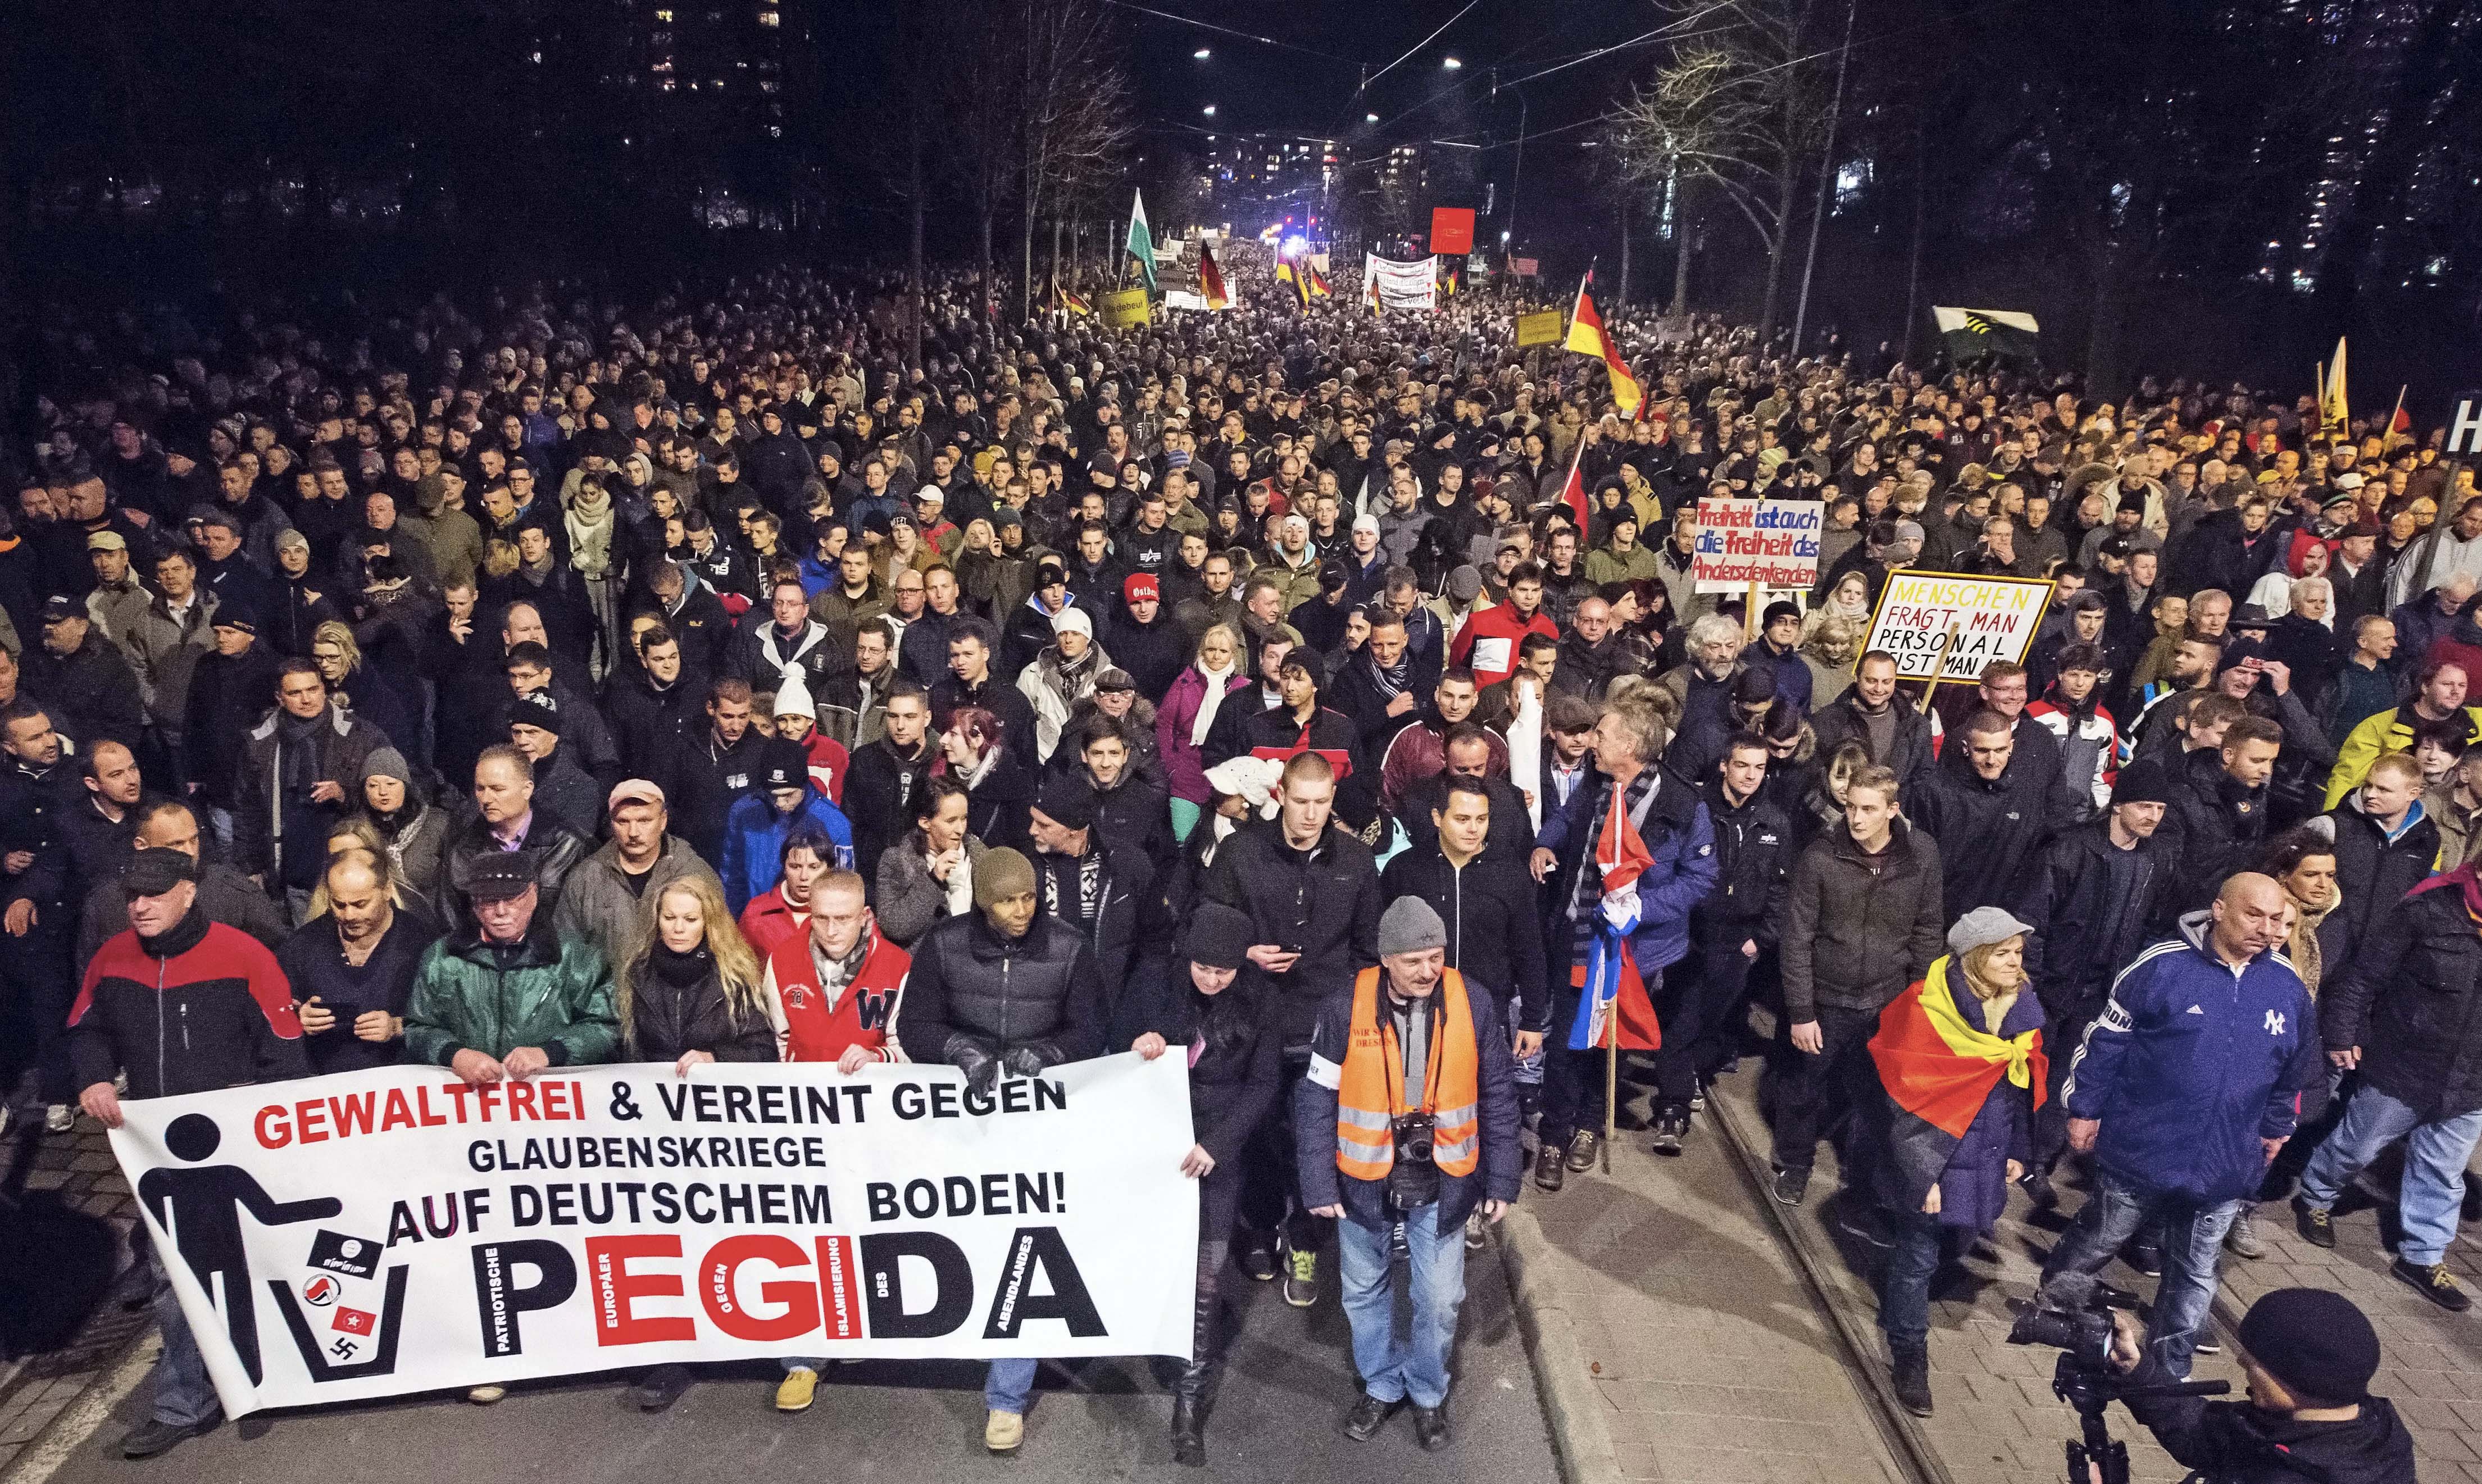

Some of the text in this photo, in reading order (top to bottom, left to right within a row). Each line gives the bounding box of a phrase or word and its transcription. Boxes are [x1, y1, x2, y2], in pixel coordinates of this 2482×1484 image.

[1698, 502, 1819, 529] Freiheit ist auch
[1695, 530, 1819, 557] die Freiheit des
[1692, 555, 1816, 584] Andersdenkenden
[1894, 581, 2032, 611] MENSCHEN
[1885, 606, 2019, 633] FRAGT MAN
[1878, 629, 2004, 655] PERSONAL
[1942, 655, 1979, 675] MAN
[2263, 1009, 2286, 1035] NY
[254, 1078, 1067, 1150] GEWALTFREI & VEREINT GEGEN
[468, 1136, 826, 1172] GLAUBENSKRIEGE
[386, 1171, 1066, 1248] AUF DEUTSCHEM BODEN!
[471, 1226, 1109, 1358] PEGIDA
[485, 1248, 510, 1352] PATRIOTISCHE
[598, 1253, 618, 1328] EUROPÄER
[713, 1263, 733, 1313] GEGEN
[828, 1237, 849, 1336] ISLAMISIERUNG
[875, 1272, 889, 1298] DES
[997, 1235, 1033, 1332] ABENDLANDES
